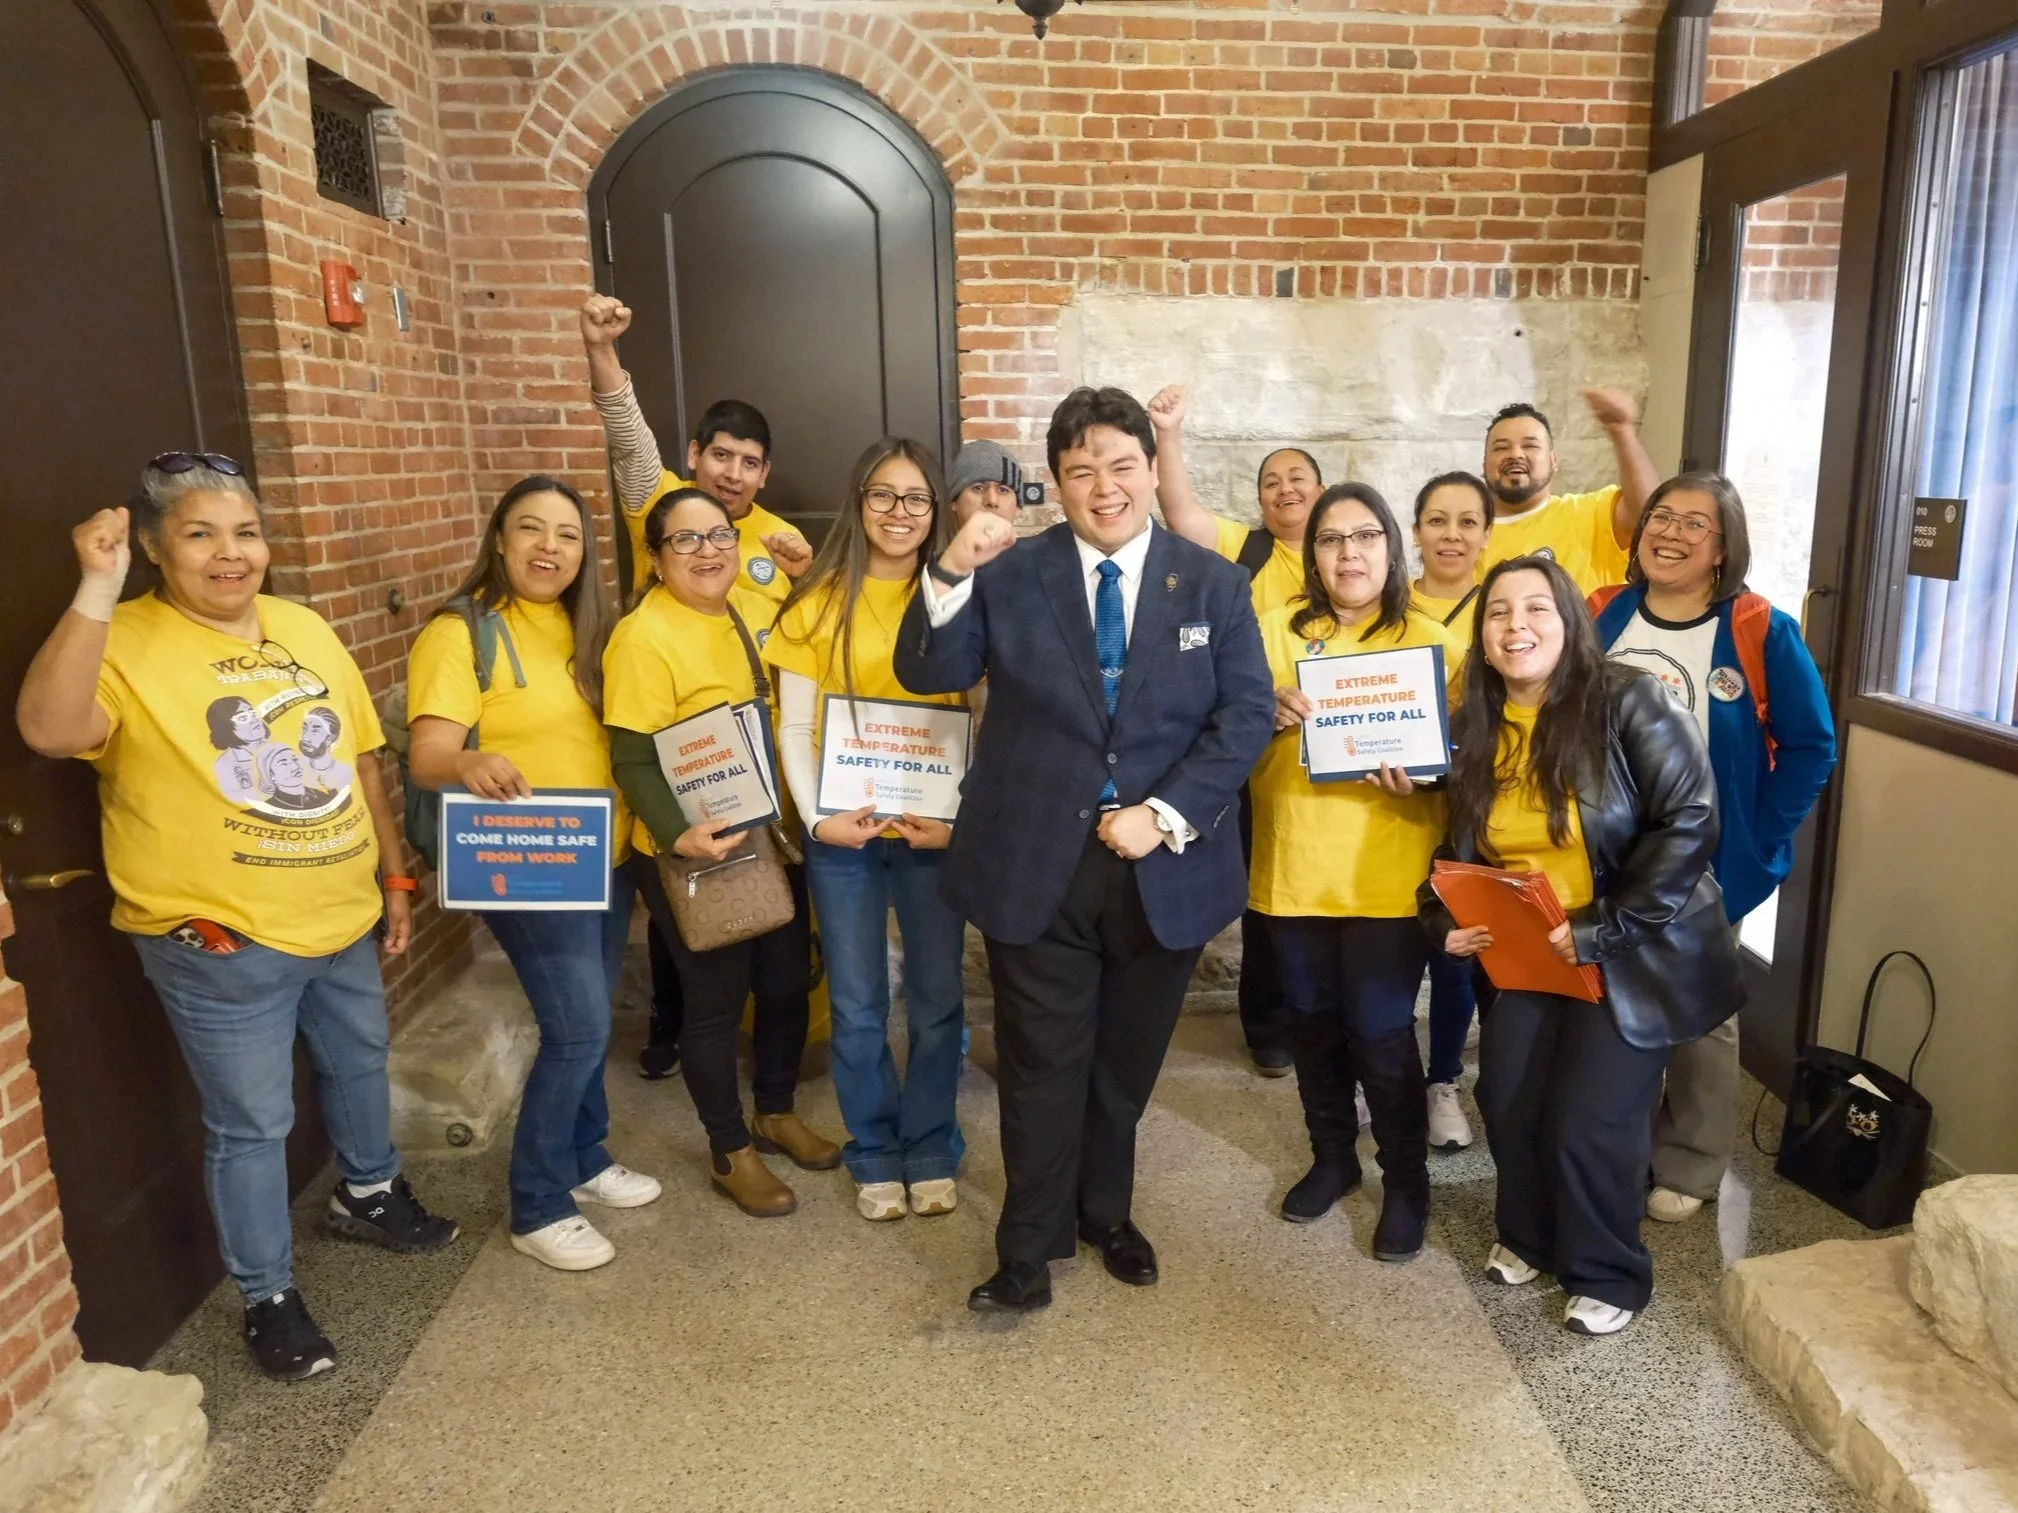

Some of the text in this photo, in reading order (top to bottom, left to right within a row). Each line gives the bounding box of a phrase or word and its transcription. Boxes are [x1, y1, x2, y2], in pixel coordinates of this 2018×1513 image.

[1914, 526, 1937, 537] PRESS
[1912, 537, 1934, 548] ROOM
[1336, 674, 1398, 690] EXTREME
[1318, 691, 1416, 710] TEMPERATURE
[1315, 708, 1427, 728] SAFETY FOR ALL
[864, 723, 931, 738] EXTREME
[678, 734, 717, 757] EXTREME
[842, 738, 946, 757] TEMPERATURE
[1355, 738, 1402, 747] Temperature
[671, 747, 735, 778] TEMPERATURE
[836, 754, 953, 776] SAFETY FOR ALL
[675, 763, 749, 796] SAFETY FOR ALL
[875, 783, 924, 795] Temperature
[223, 806, 366, 842] WITHOUT FEAR
[473, 815, 581, 829] I DESERVE TO
[456, 832, 598, 846] COME HOME SAFE
[245, 856, 268, 866] END
[269, 858, 323, 867] IMMIGRANT
[476, 851, 577, 864] FROM WORK
